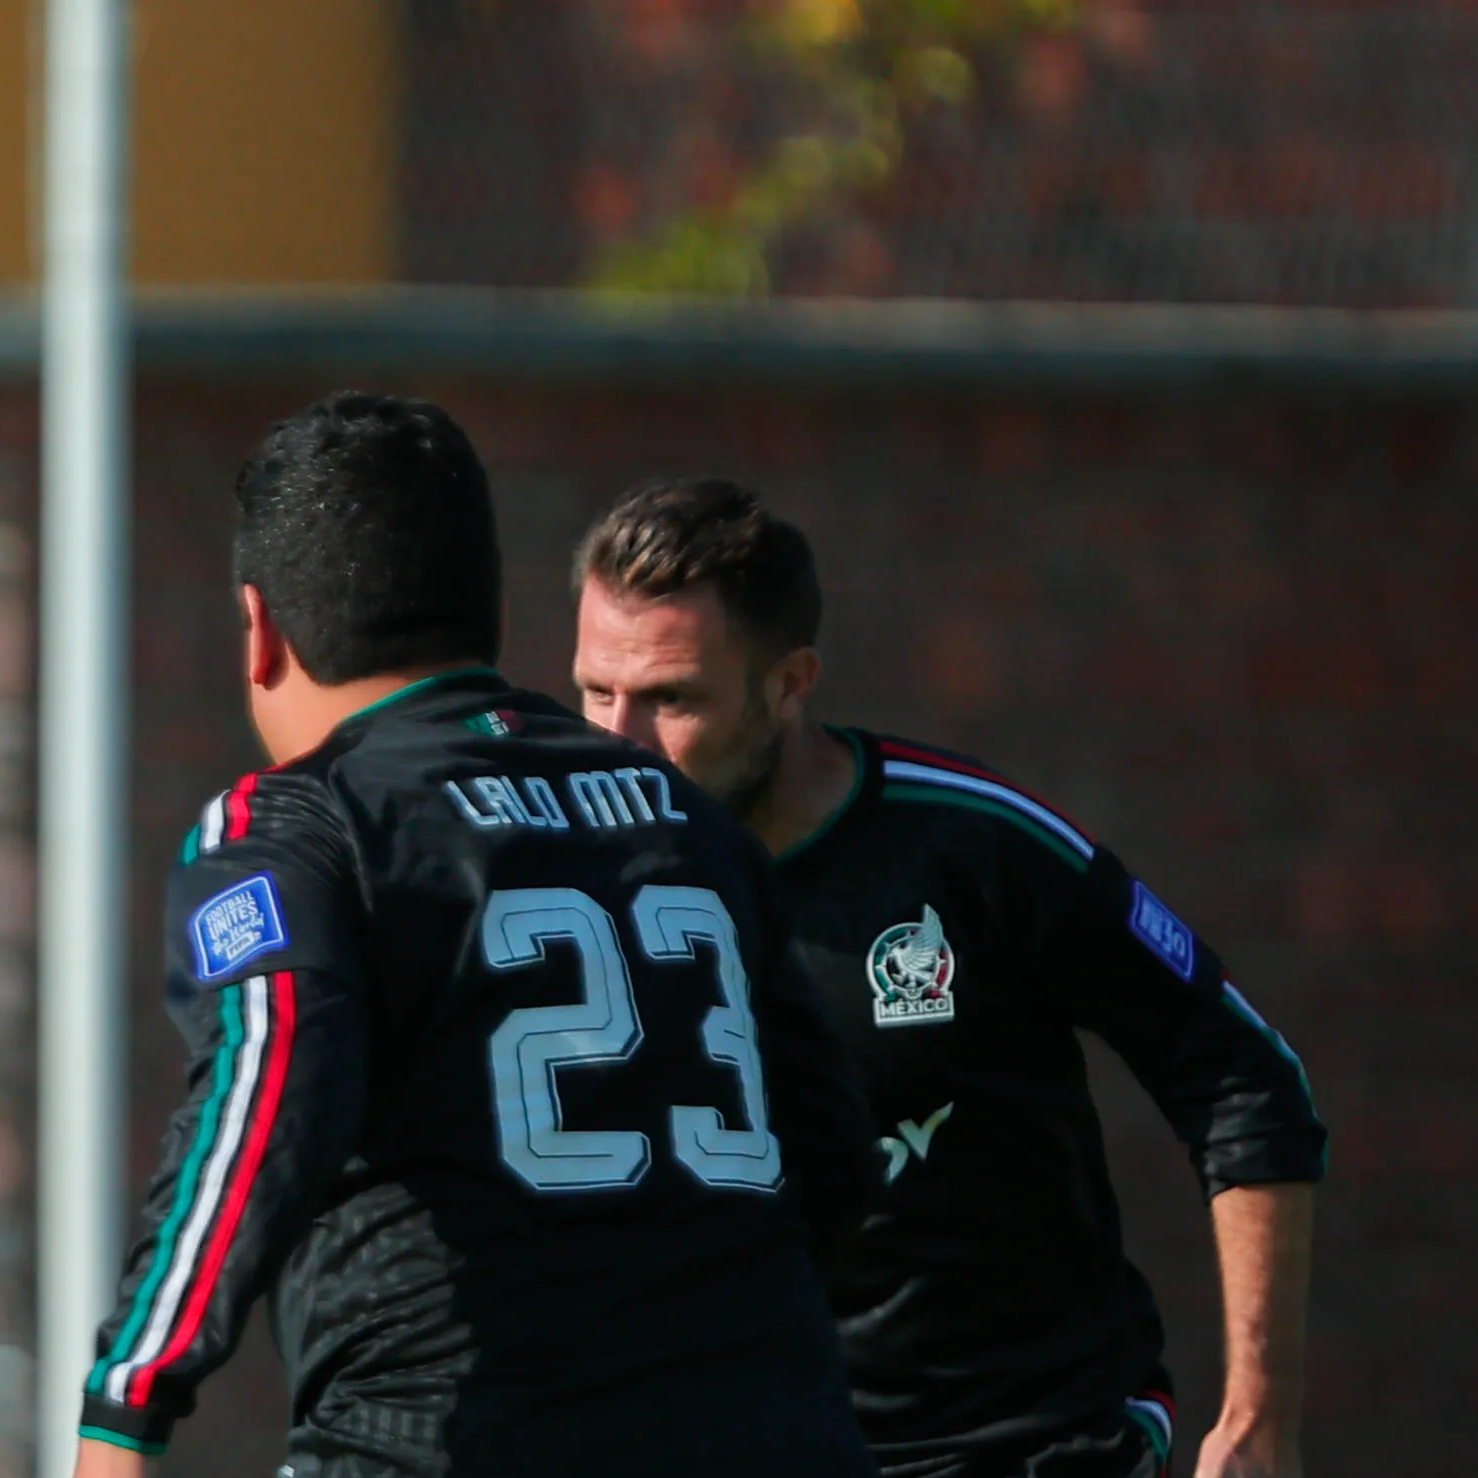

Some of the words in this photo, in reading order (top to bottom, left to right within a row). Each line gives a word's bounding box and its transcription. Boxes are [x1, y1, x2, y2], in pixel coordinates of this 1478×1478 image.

[445, 775, 570, 828] LALO
[568, 767, 688, 828] MTZ
[205, 890, 254, 924] FOOTBALL
[207, 899, 259, 942] UNITES
[482, 884, 785, 1193] 23
